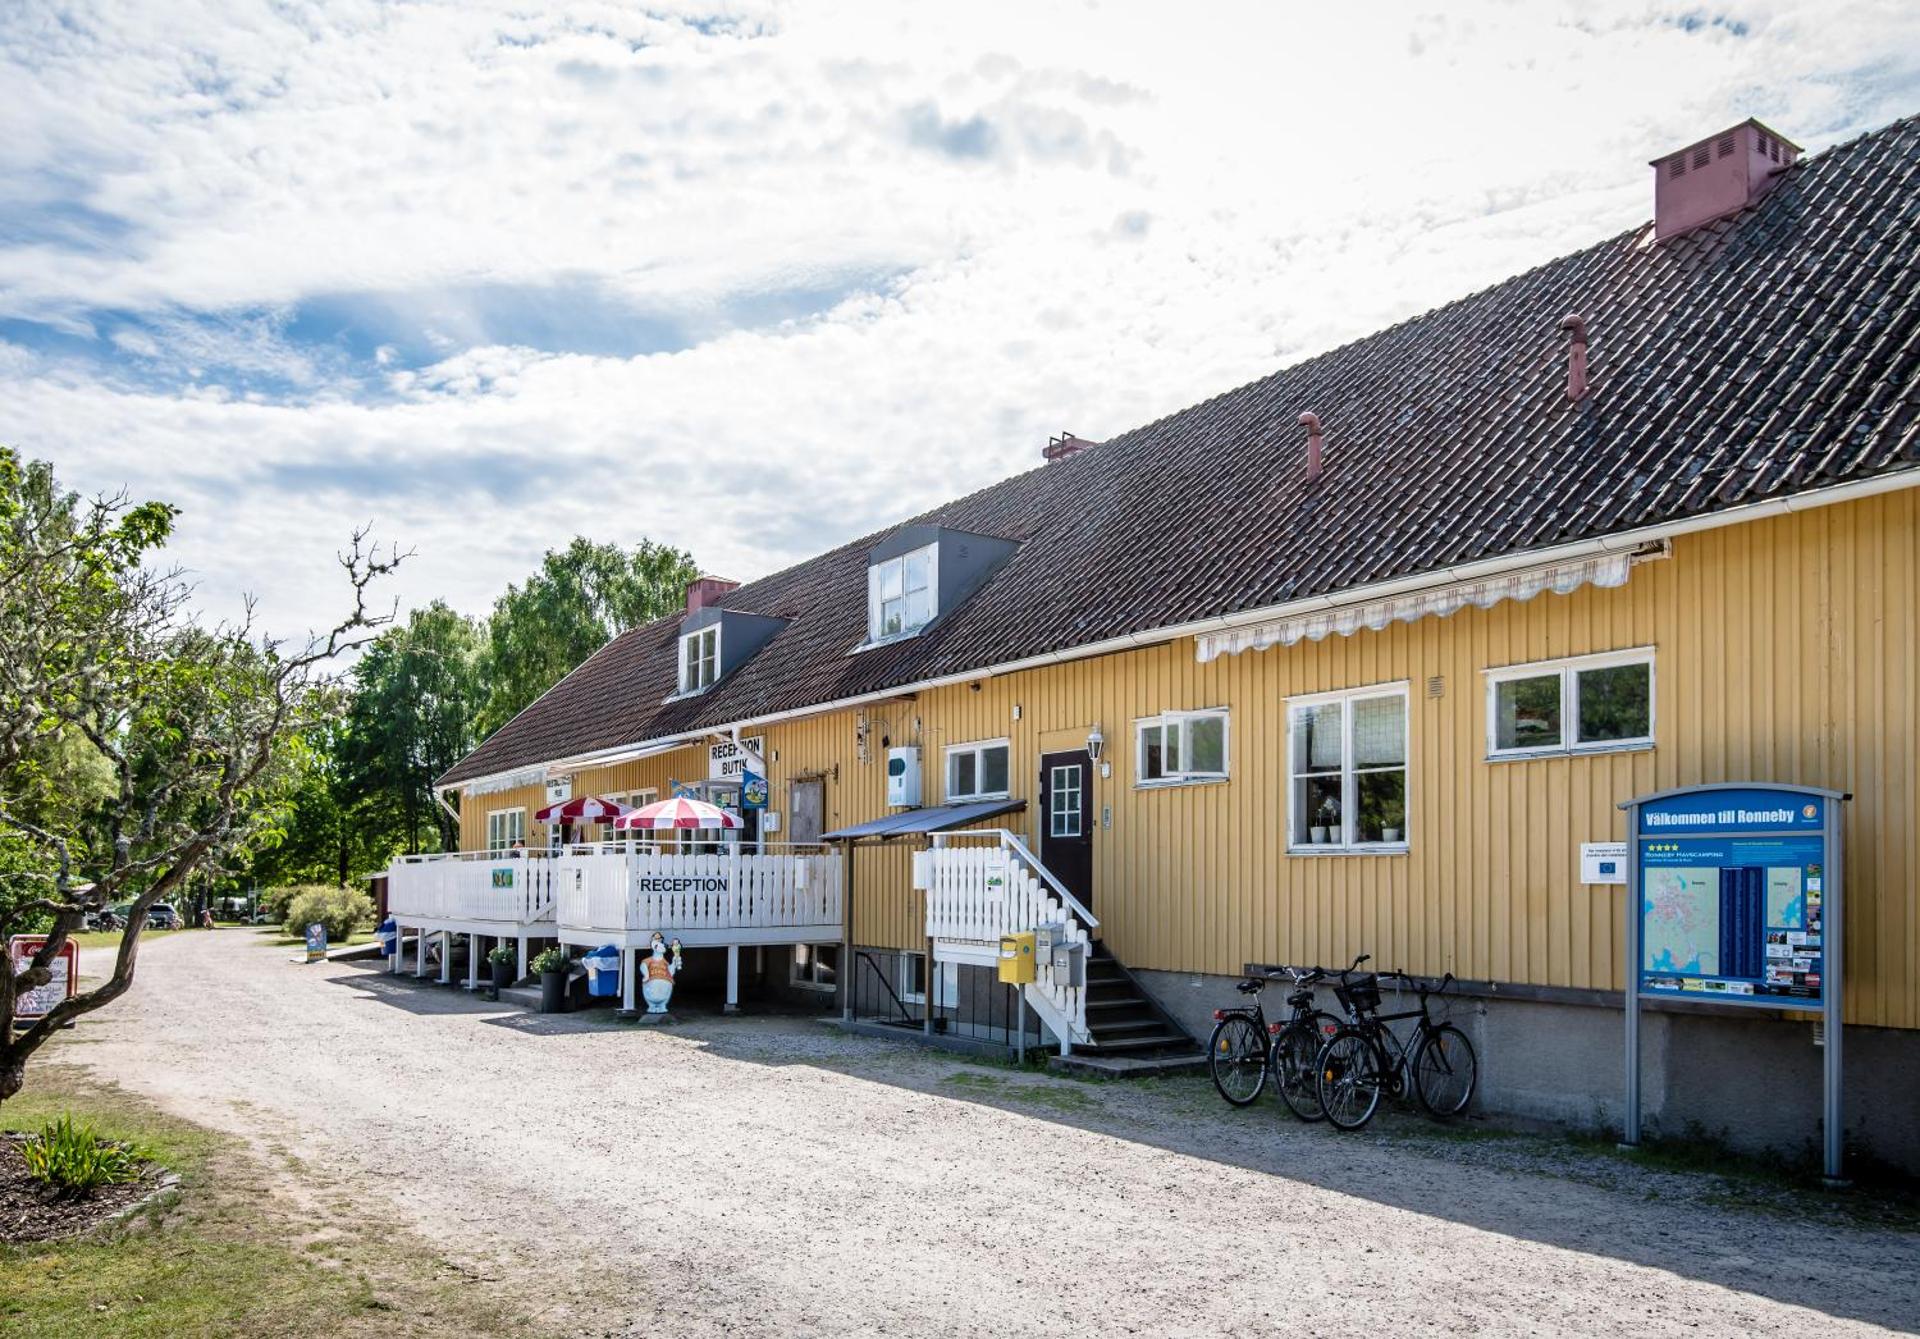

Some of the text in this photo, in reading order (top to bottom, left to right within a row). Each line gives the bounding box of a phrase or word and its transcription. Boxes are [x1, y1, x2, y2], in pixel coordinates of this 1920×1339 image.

[711, 737, 760, 760] RECEPION
[722, 758, 748, 775] BUTIK
[1645, 808, 1795, 827] Välkommen till Ronneby
[640, 878, 728, 892] RECEPTION
